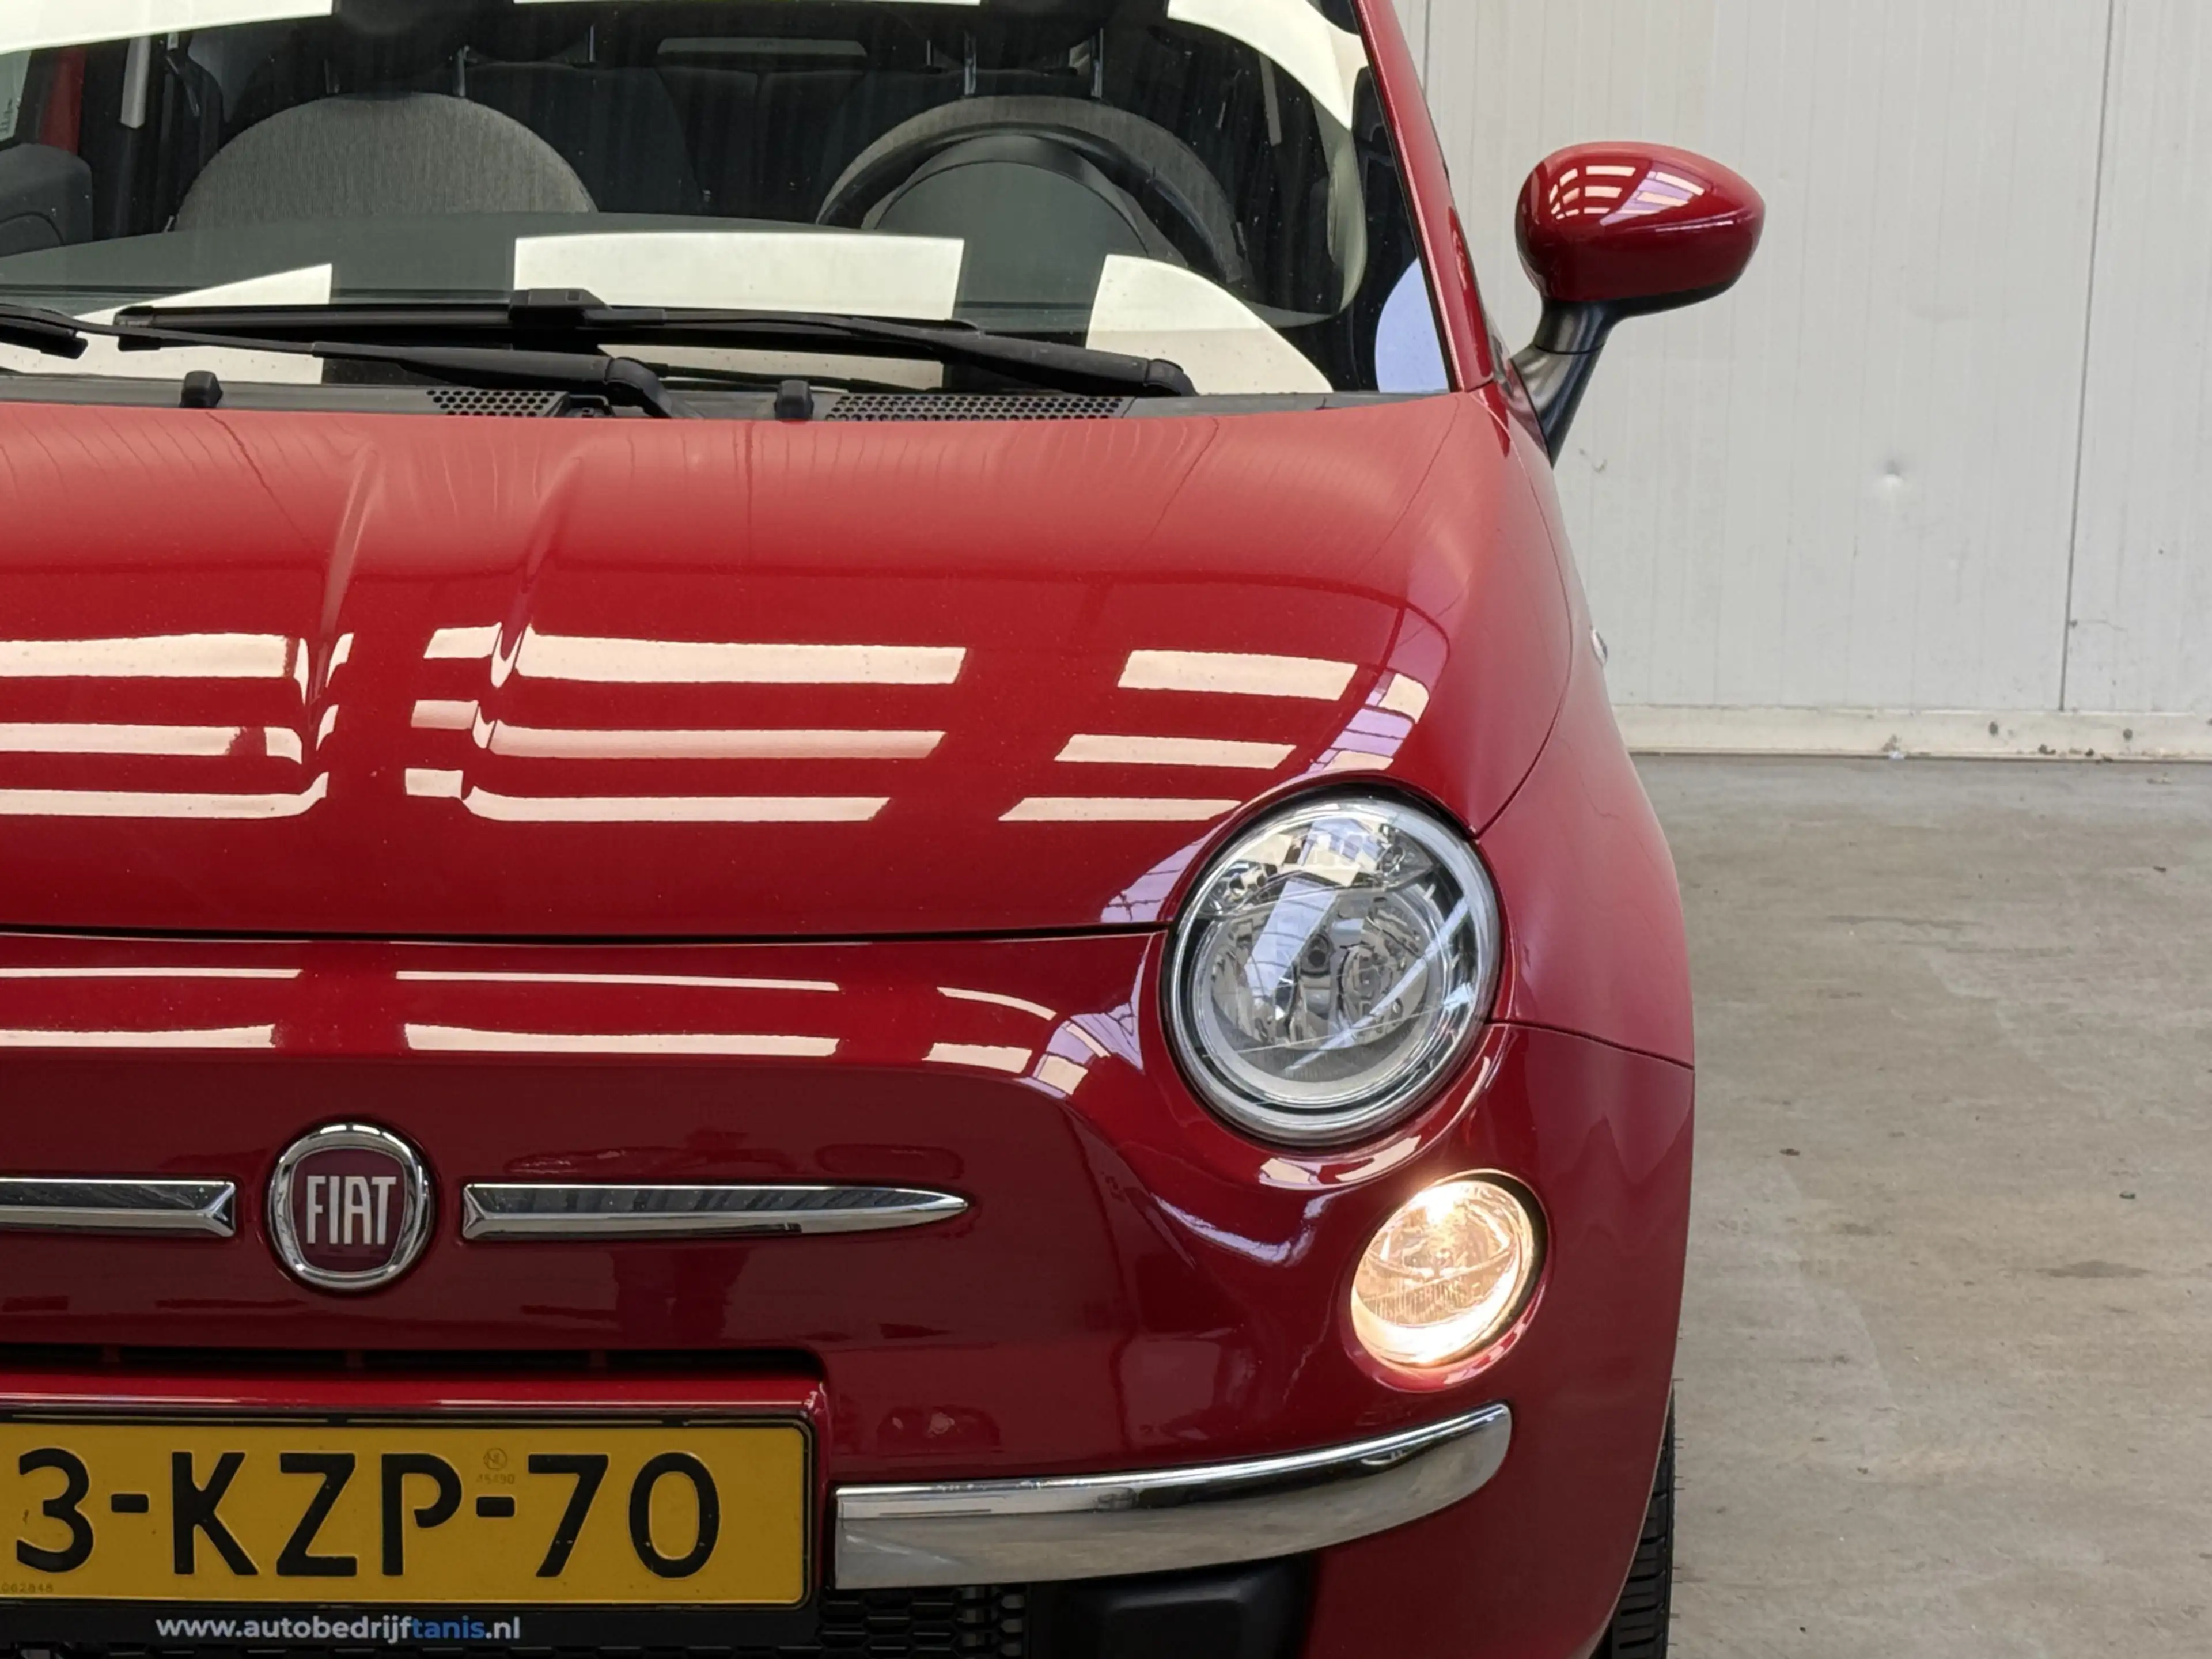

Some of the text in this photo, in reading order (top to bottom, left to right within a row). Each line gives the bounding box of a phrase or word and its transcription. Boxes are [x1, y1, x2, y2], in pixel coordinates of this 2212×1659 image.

[306, 1176, 397, 1245] FIAT
[16, 1447, 721, 1579] 3-KZP-70
[155, 1616, 520, 1643] www.autobedrijftanis.nl
